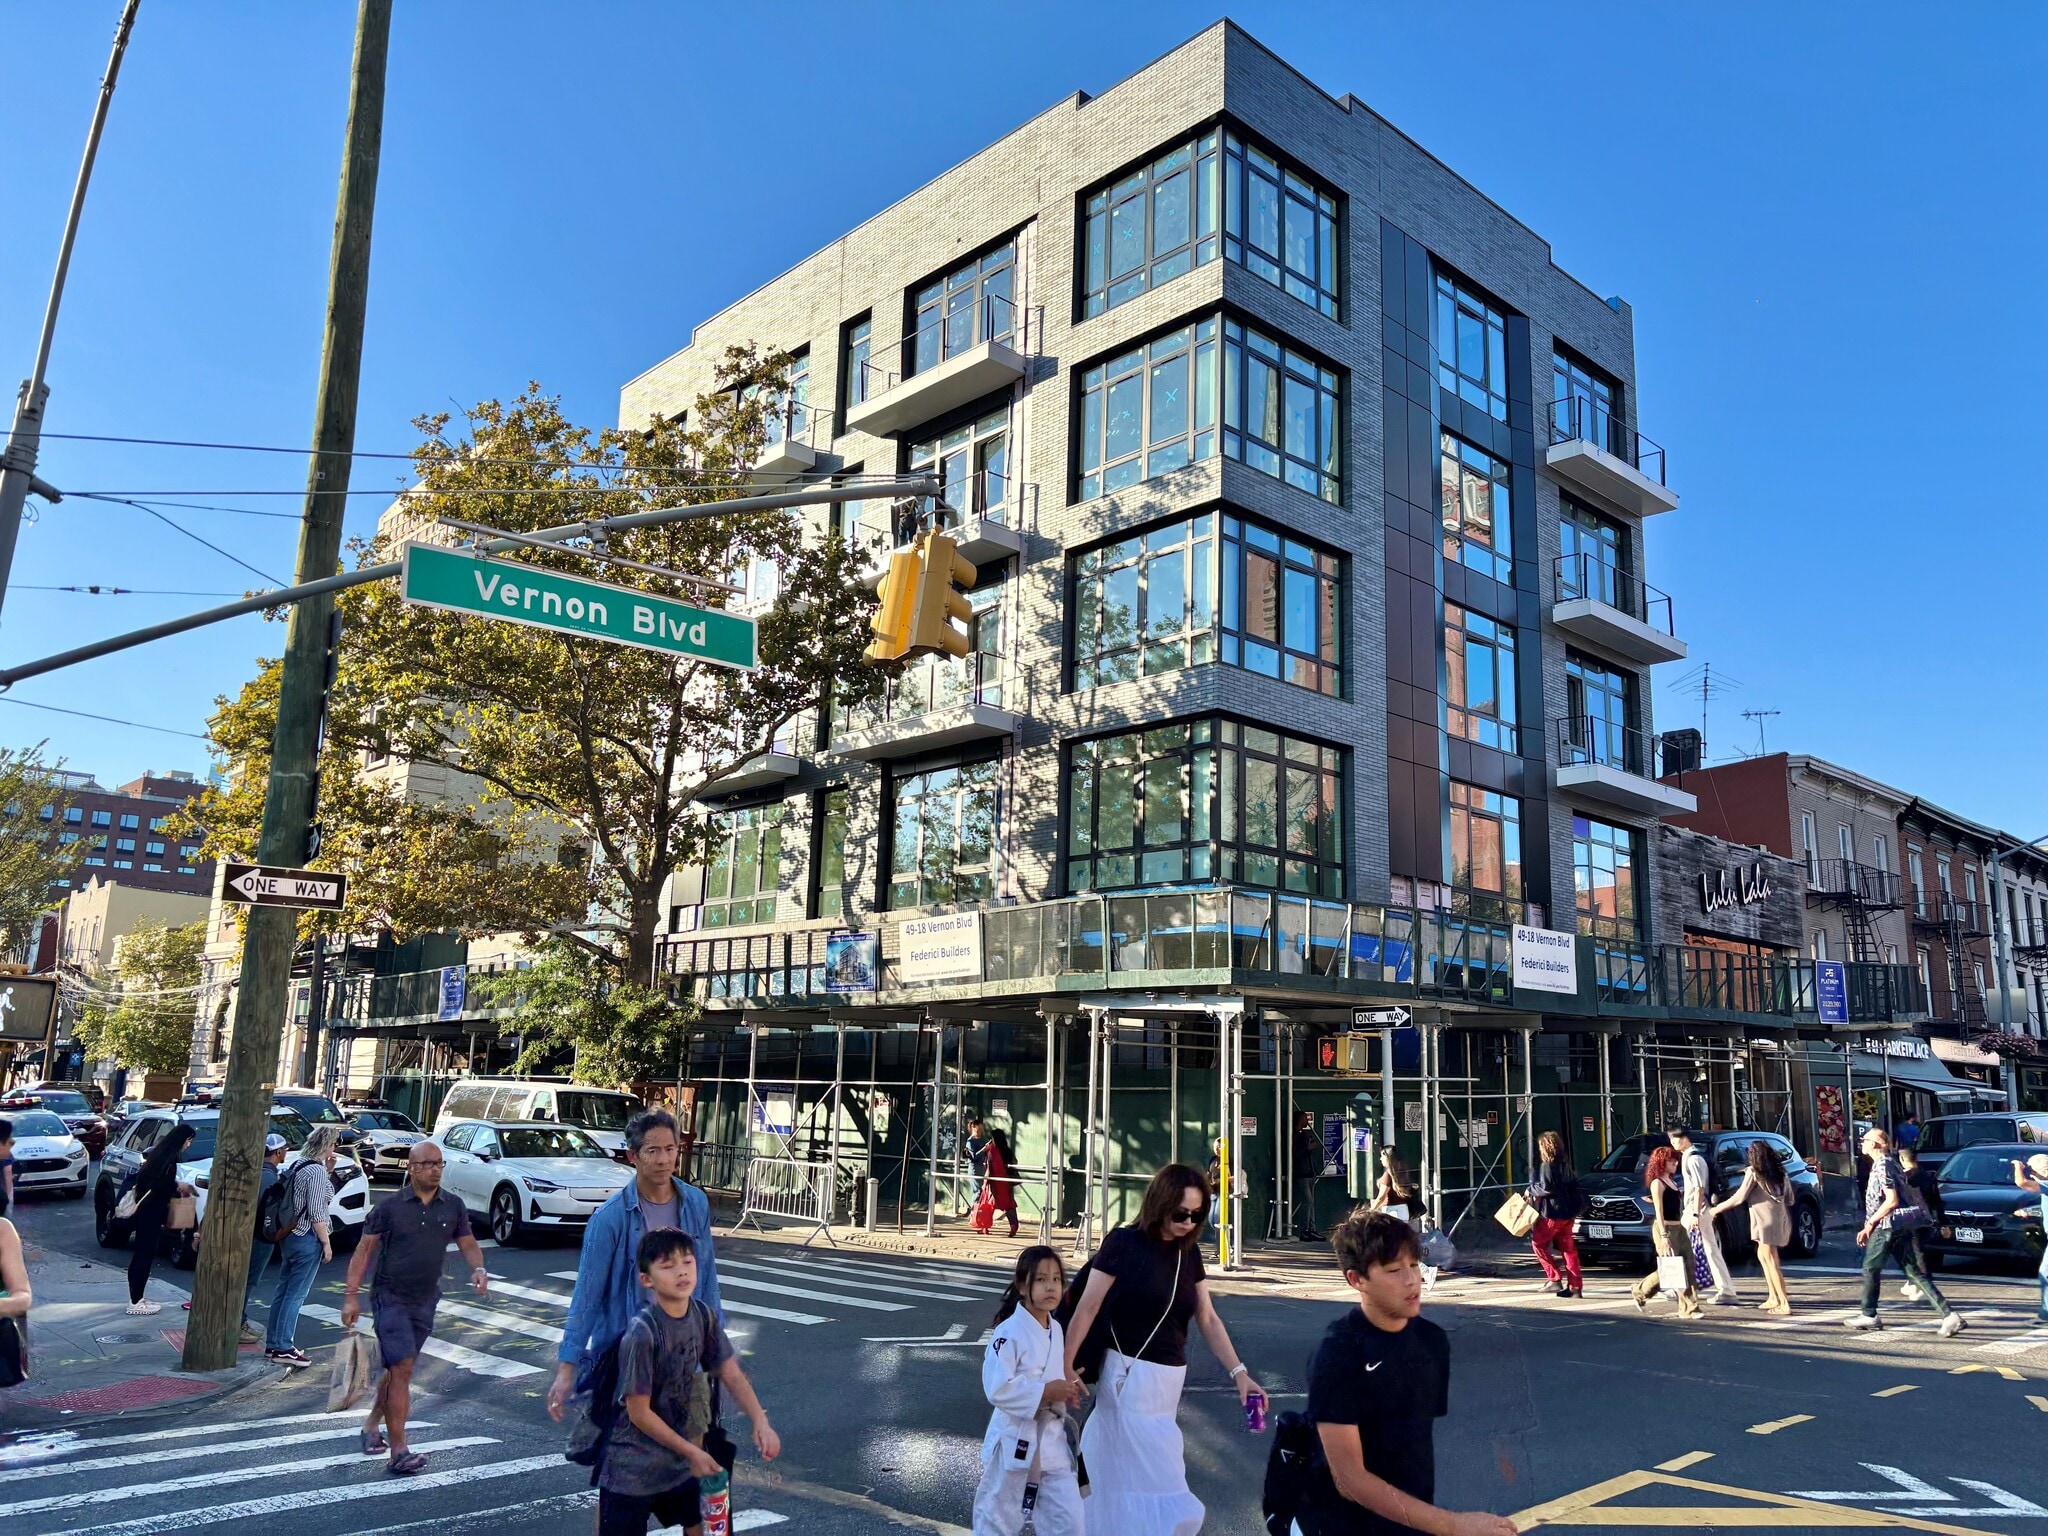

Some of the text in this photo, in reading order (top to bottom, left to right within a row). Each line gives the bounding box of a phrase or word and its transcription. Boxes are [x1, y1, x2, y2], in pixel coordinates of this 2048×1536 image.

[474, 570, 706, 647] Vernon Blvd
[243, 877, 331, 898] ONE WAY
[1701, 862, 1772, 913] Lulu Lala
[905, 915, 973, 936] 49-18 Vernon Blvd
[1517, 929, 1570, 948] 49-18 Vernon Blvd
[910, 945, 971, 962] Federici Builders
[1521, 957, 1570, 974] Federici Builders
[1357, 1012, 1405, 1023] ONE WAY
